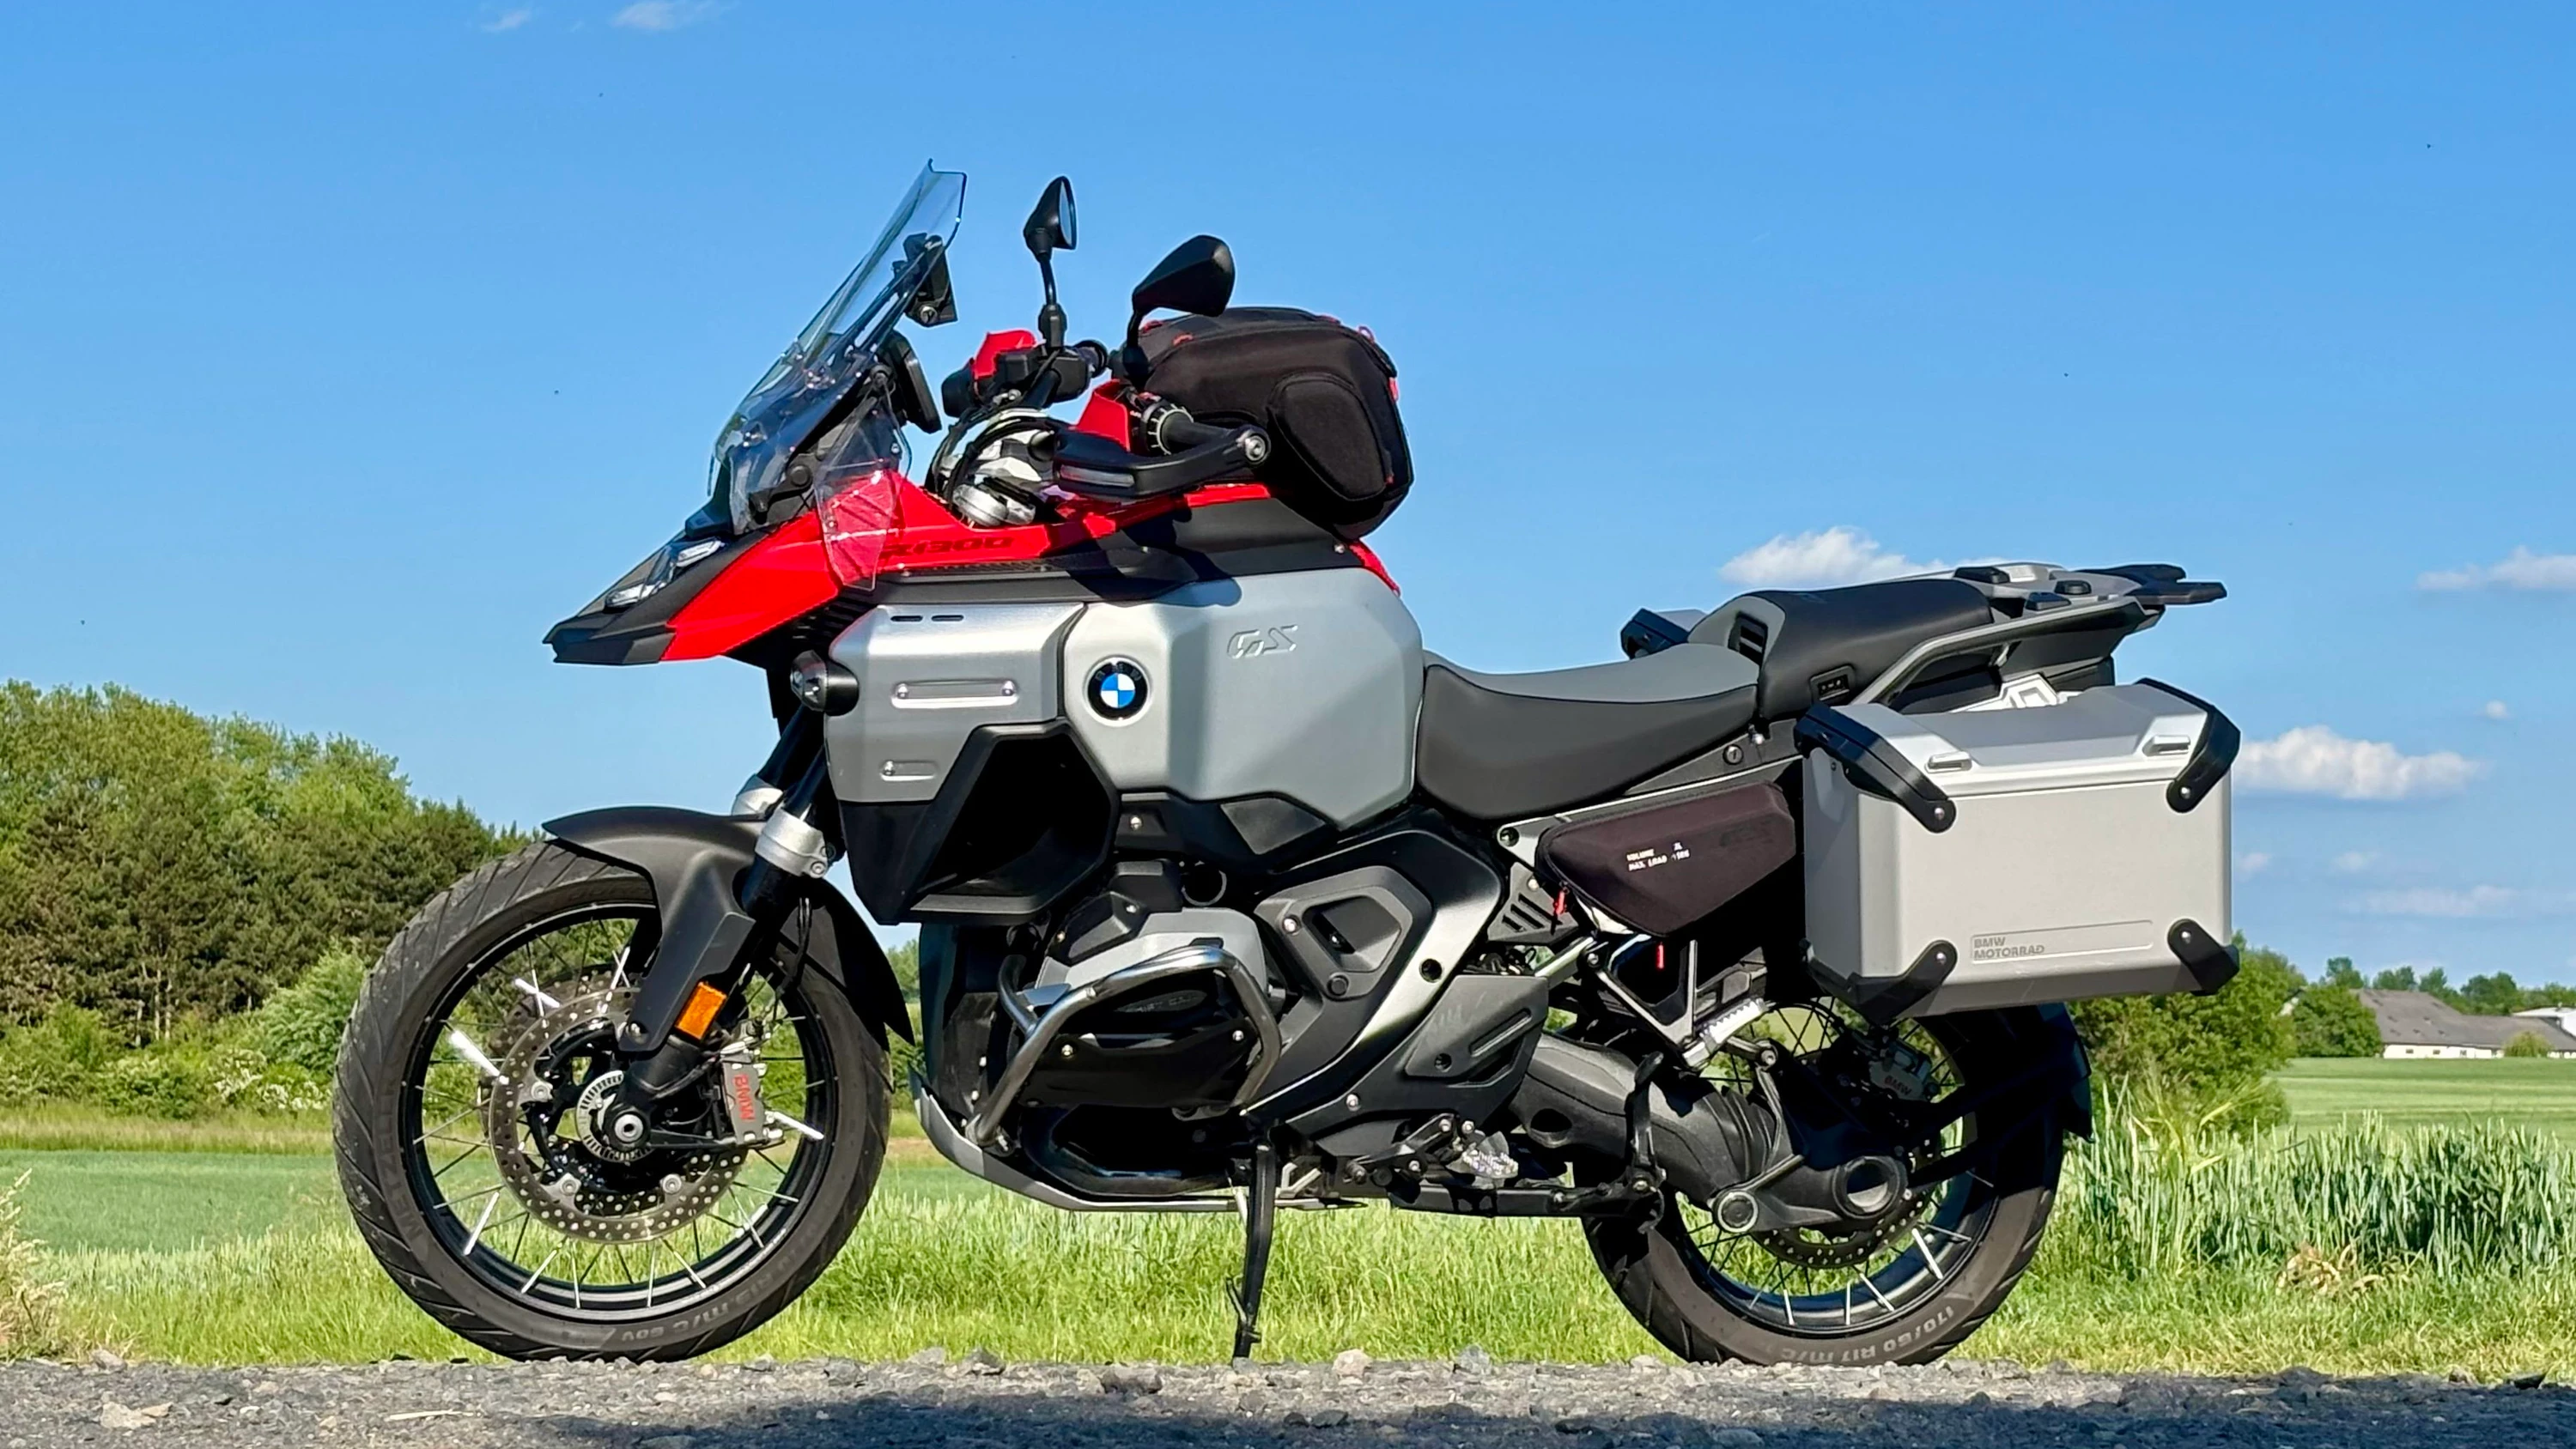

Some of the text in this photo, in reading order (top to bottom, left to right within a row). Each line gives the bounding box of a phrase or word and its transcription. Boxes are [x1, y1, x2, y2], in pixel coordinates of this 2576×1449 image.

[1226, 624, 1298, 658] GS
[1975, 937, 2006, 949] BMW
[1975, 945, 2045, 960] MOTORRAD
[732, 1074, 756, 1121] BMW
[1883, 1306, 1955, 1353] 170/60
